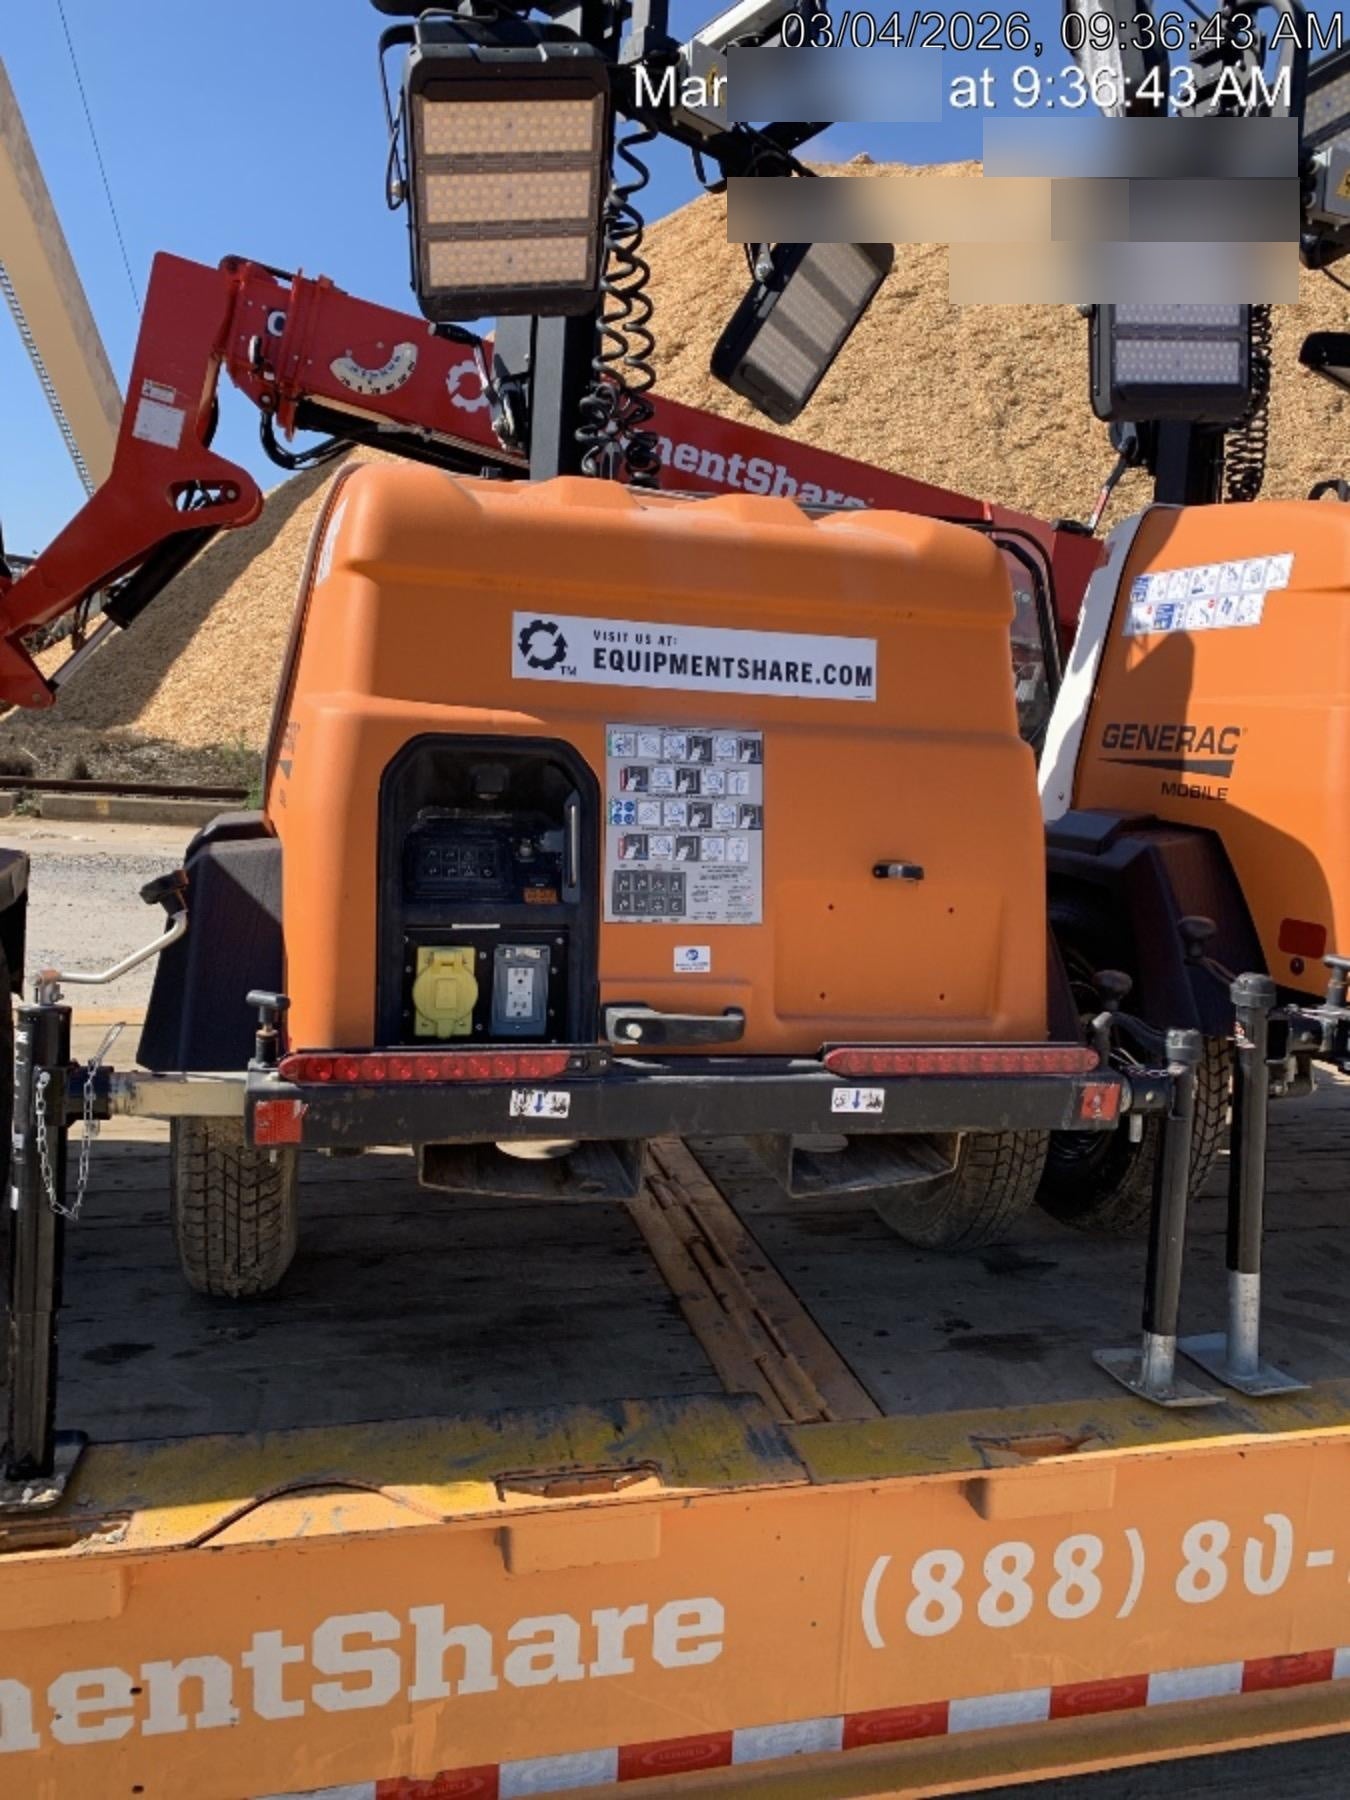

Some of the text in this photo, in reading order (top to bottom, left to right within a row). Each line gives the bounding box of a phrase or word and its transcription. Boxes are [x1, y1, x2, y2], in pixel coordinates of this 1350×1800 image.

[593, 629, 629, 642] VISIT
[635, 633, 651, 645] US
[560, 665, 576, 677] TM
[594, 648, 872, 687] EQUIPMENTSHARE.COM
[1102, 723, 1240, 755] GENERAC
[1161, 781, 1229, 800] MOBILE
[861, 1527, 1146, 1649] (888)
